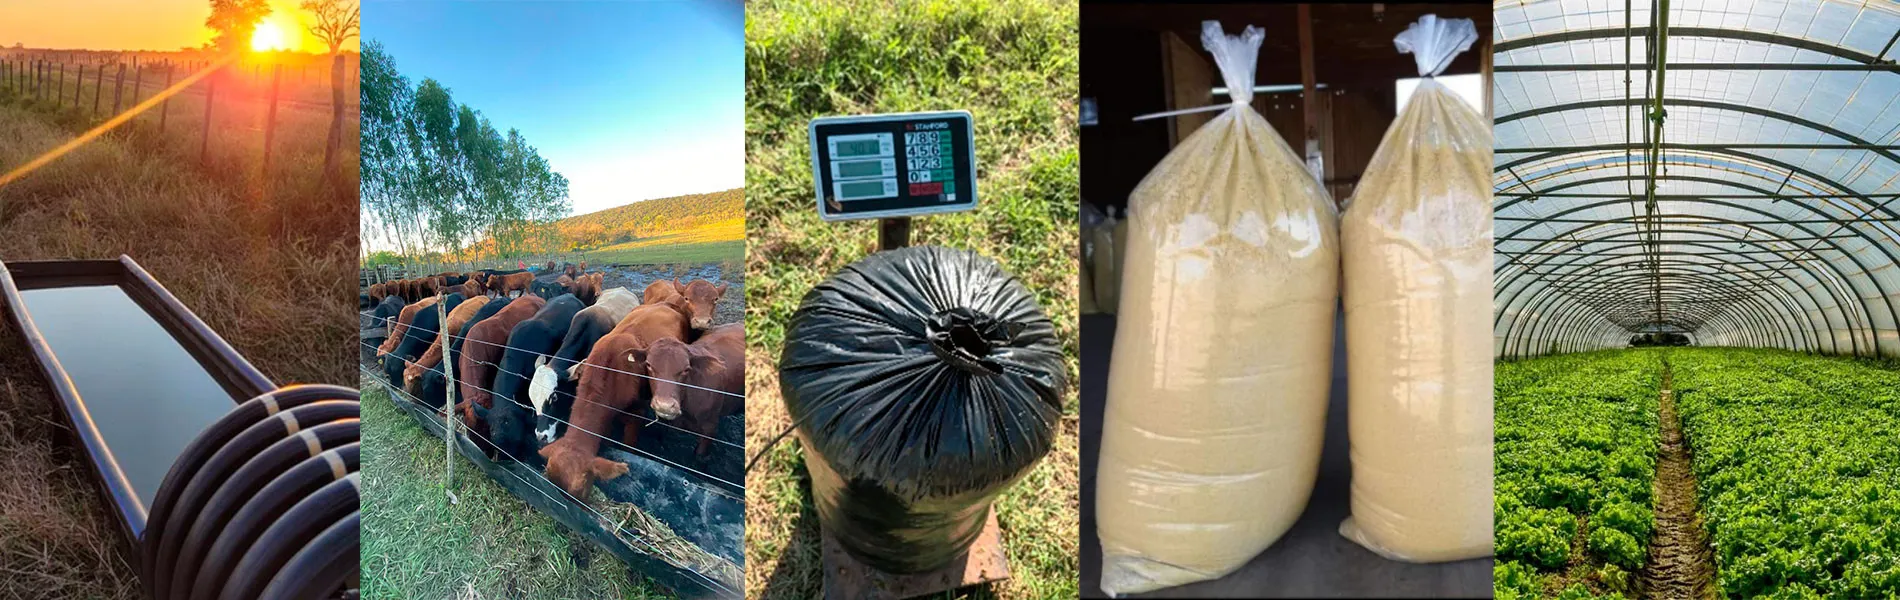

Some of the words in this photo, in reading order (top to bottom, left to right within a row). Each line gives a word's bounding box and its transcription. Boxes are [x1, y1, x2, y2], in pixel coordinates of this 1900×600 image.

[915, 122, 949, 130] STANFORD
[908, 133, 915, 143] 7
[918, 132, 926, 143] 8
[930, 132, 938, 143] 9
[908, 146, 915, 156] 4
[920, 146, 928, 156] 5
[932, 144, 939, 155] 6
[921, 159, 928, 169] 2
[933, 157, 940, 168] 3
[910, 172, 918, 182] 0
